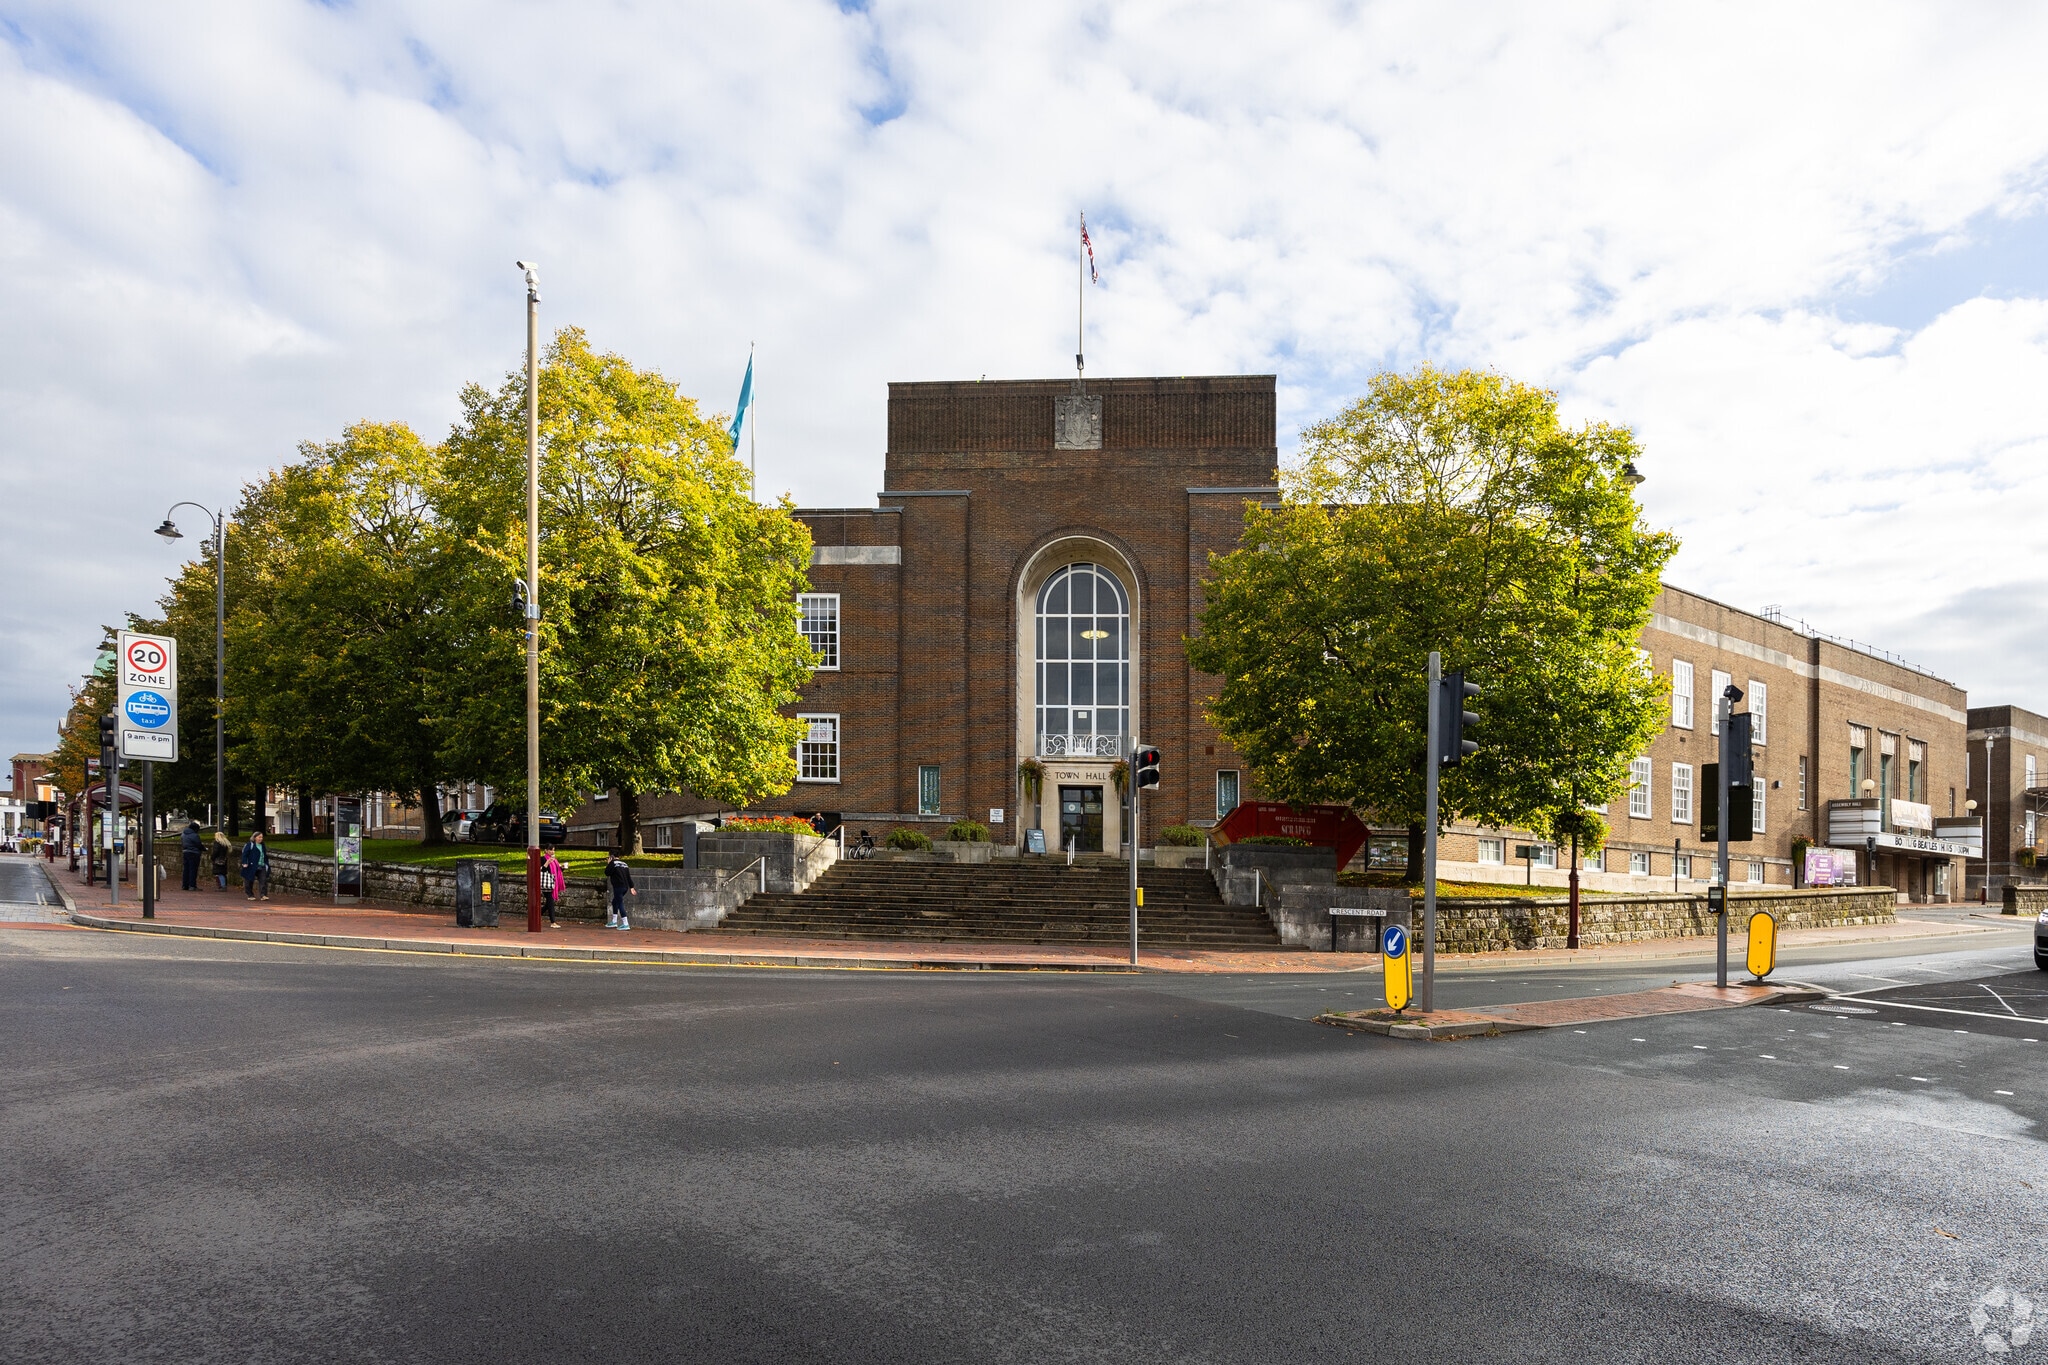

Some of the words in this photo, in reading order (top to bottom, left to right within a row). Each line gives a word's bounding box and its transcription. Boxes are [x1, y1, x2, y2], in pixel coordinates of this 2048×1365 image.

[134, 649, 161, 664] 20
[130, 673, 166, 685] ZONE
[1331, 908, 1364, 916] CRESCENT
[1366, 909, 1385, 917] ROAD
